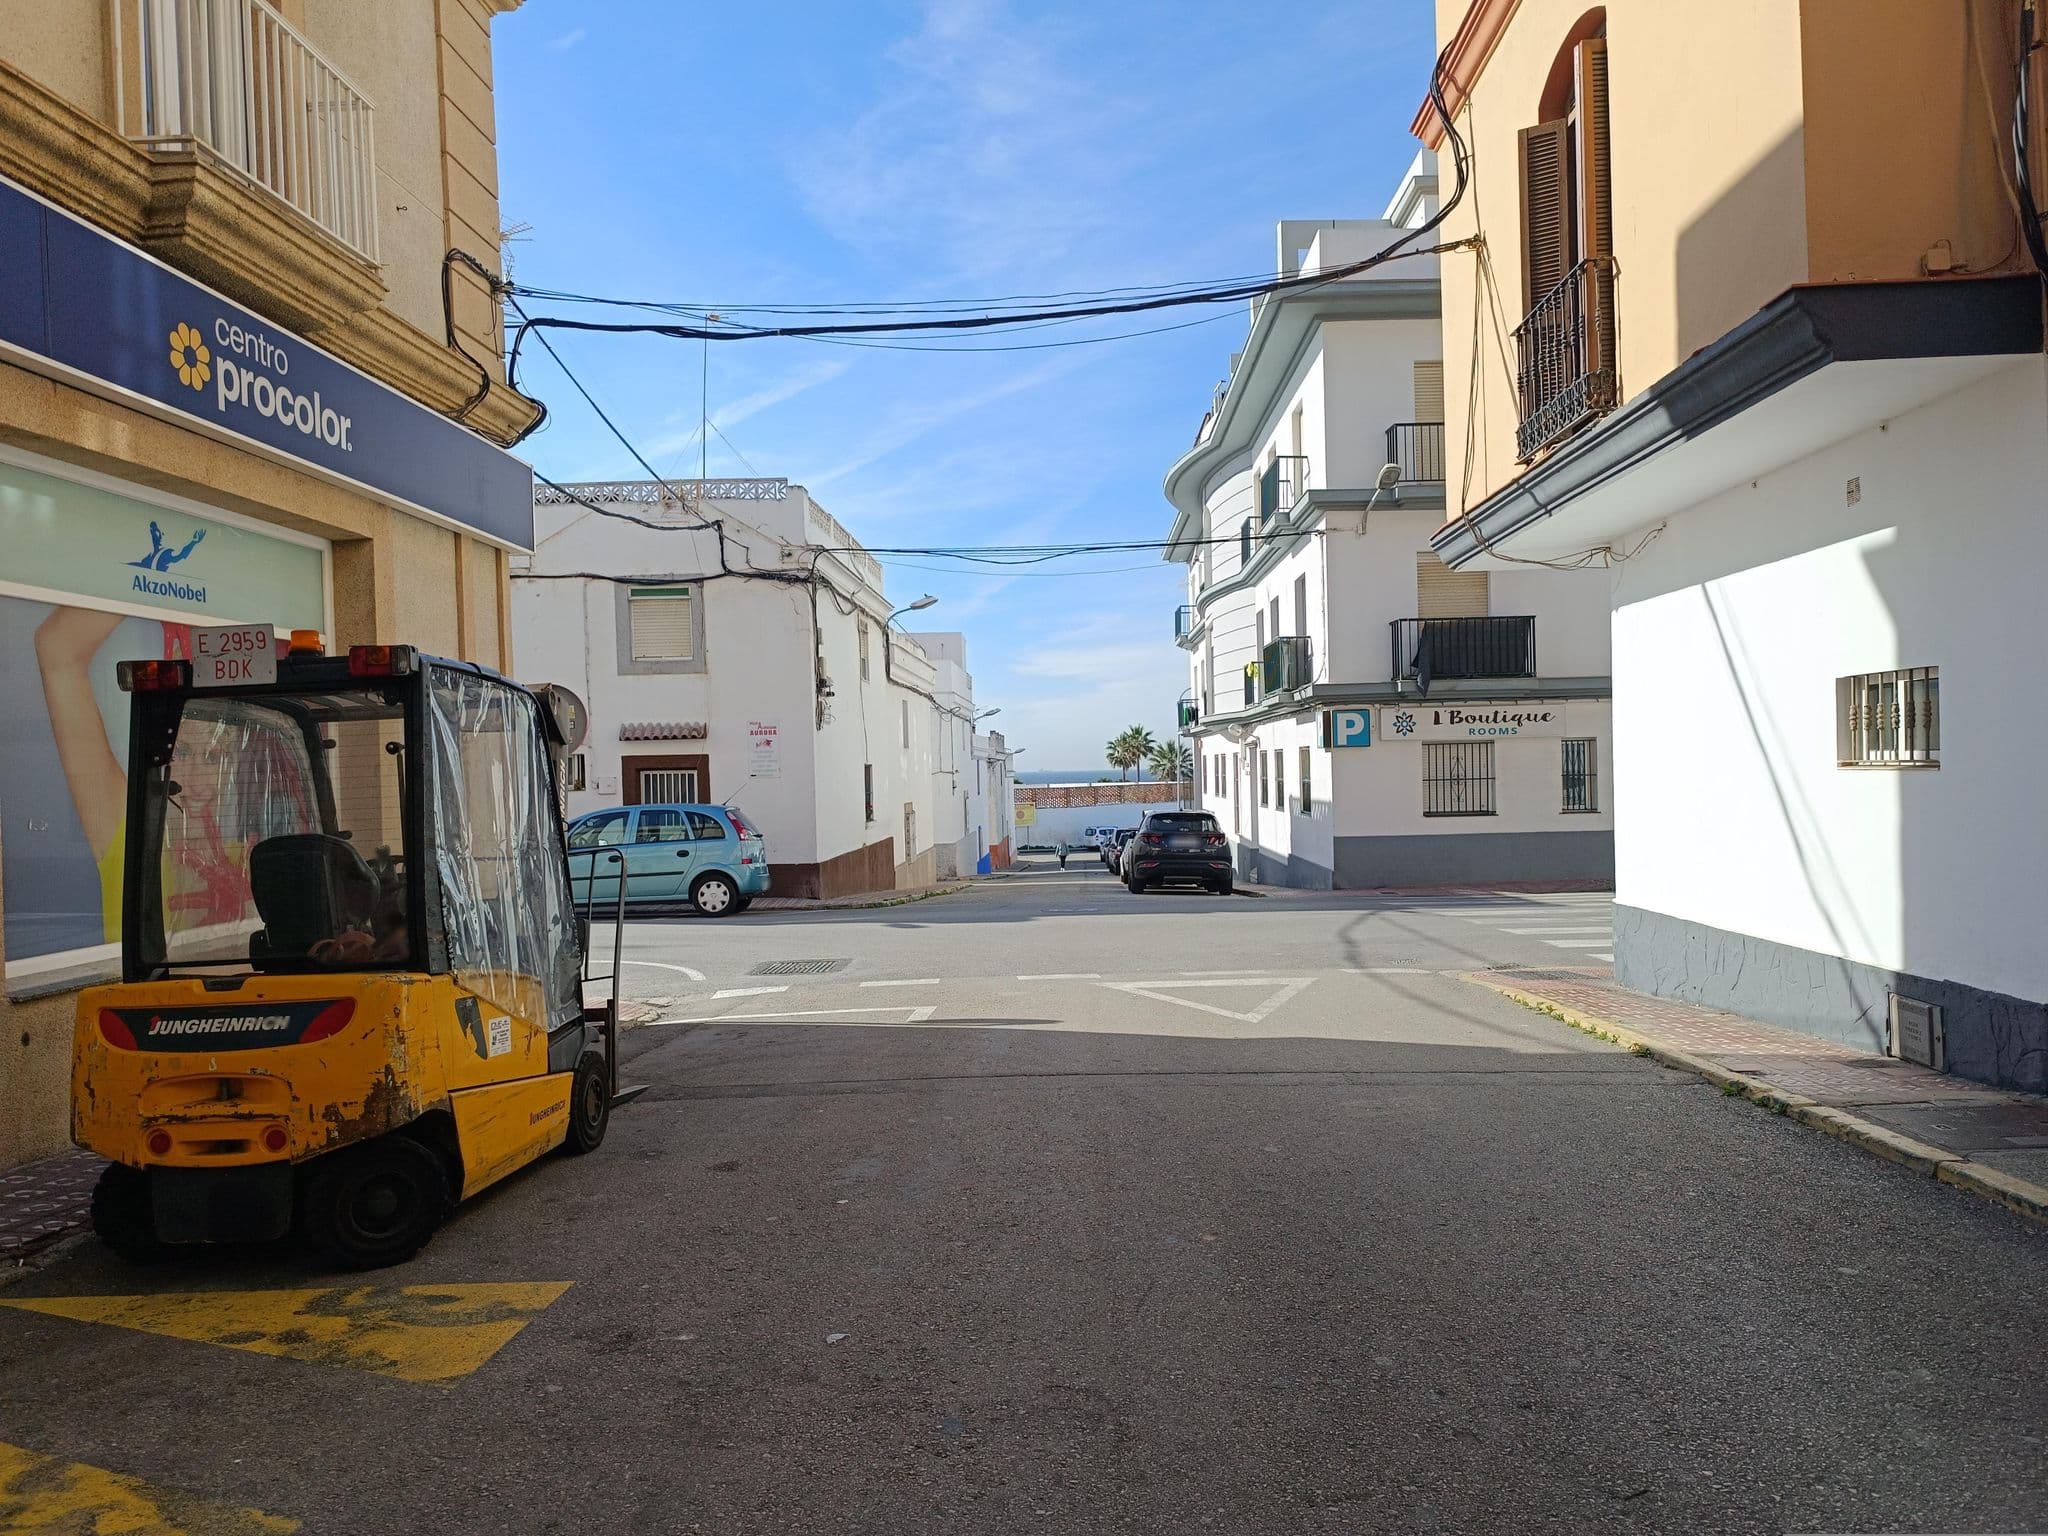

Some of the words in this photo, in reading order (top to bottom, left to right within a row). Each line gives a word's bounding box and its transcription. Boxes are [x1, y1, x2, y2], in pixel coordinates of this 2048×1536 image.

[215, 318, 289, 376] centro
[132, 574, 207, 603] AkzoNobel
[199, 633, 210, 654] E
[219, 630, 266, 652] 2959
[215, 658, 253, 680] BDK
[1336, 712, 1365, 746] P
[1468, 727, 1519, 736] ROOMS
[148, 1015, 291, 1036] JUNGHEINRICH
